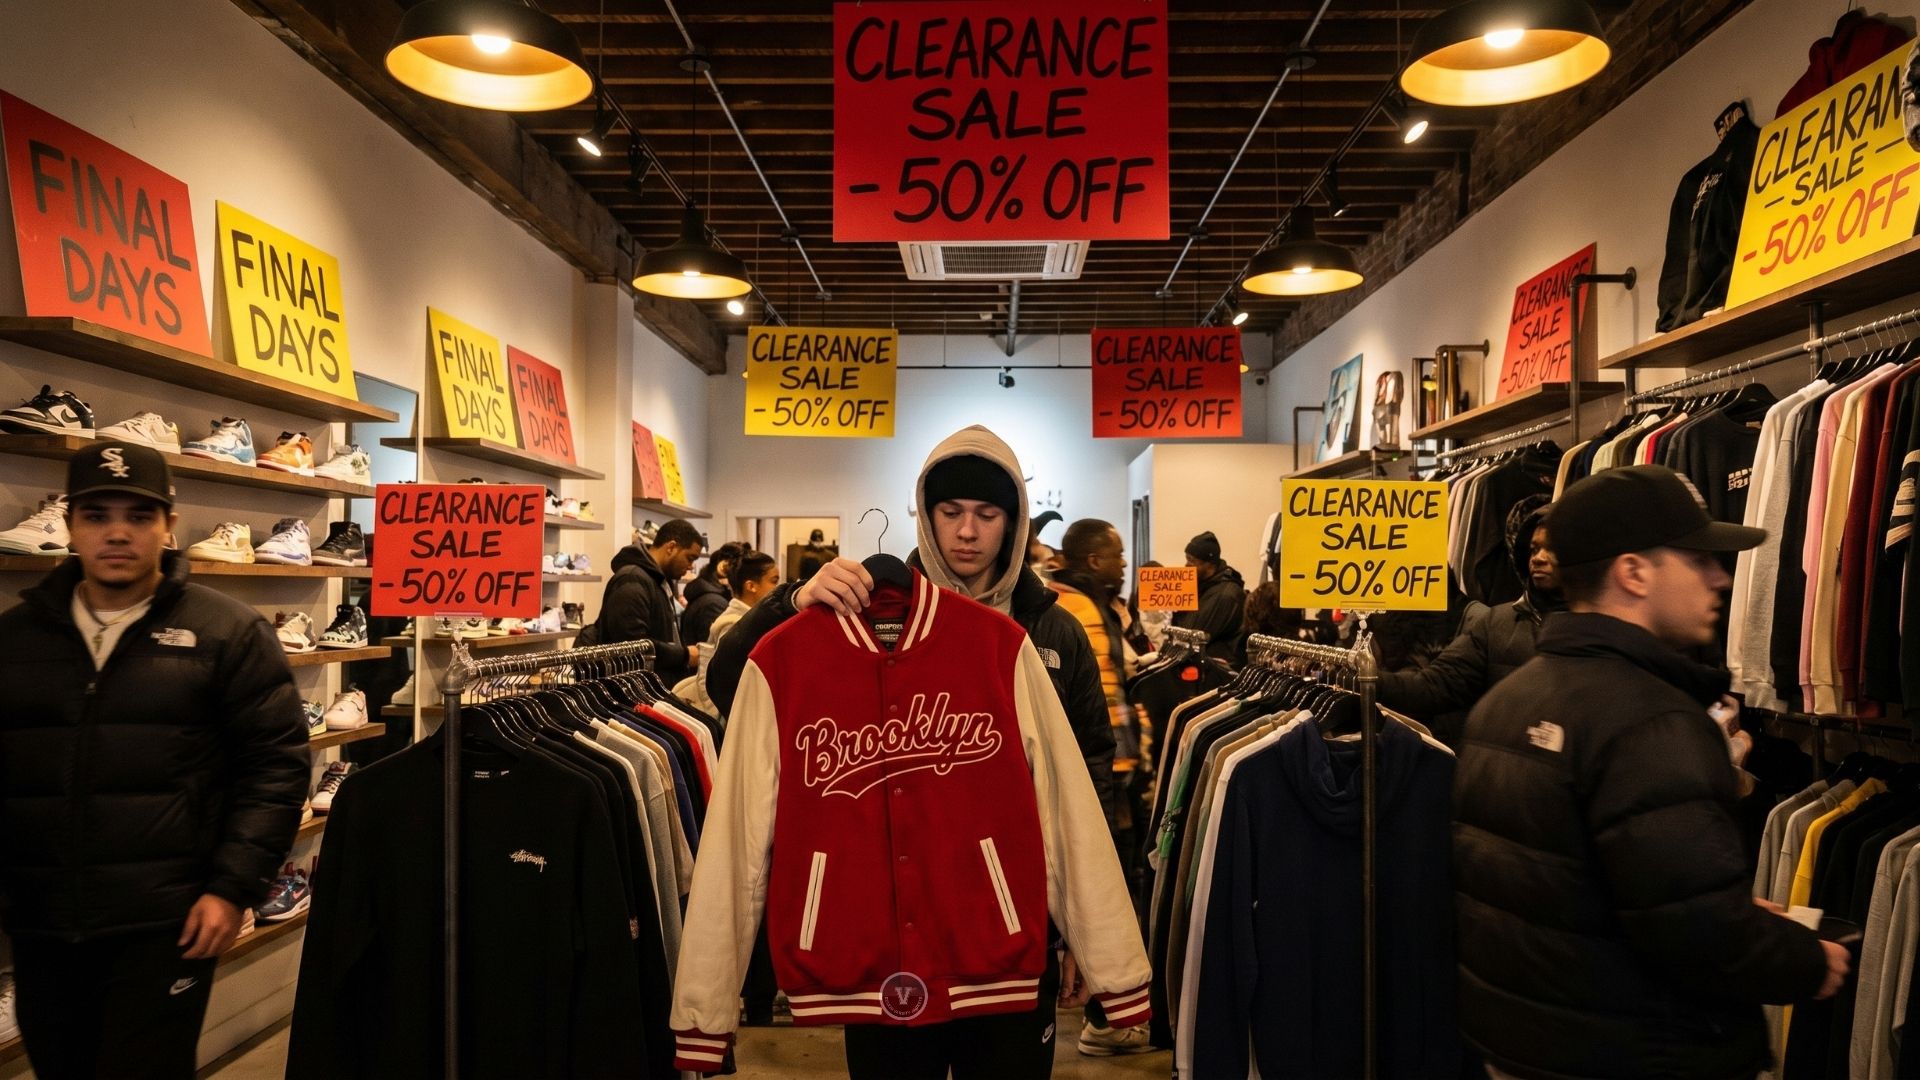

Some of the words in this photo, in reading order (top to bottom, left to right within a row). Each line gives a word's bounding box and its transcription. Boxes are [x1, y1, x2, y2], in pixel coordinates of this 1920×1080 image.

[845, 15, 1158, 83] CLEARANCE
[907, 87, 1088, 142] SALE
[28, 138, 192, 271] FINAL
[1042, 156, 1154, 224] OFF
[1837, 162, 1920, 245] OFF
[60, 236, 182, 336] DAYS
[231, 229, 340, 322] FINAL
[248, 304, 340, 384] DAYS
[1519, 306, 1563, 350] SALE
[439, 330, 504, 394] FINAL
[751, 333, 892, 364] CLEARANCE
[1095, 334, 1235, 366] CLEARANCE
[1539, 340, 1571, 381] OFF
[516, 364, 567, 418] FINAL
[779, 365, 860, 391] SALE
[1125, 366, 1203, 392] SALE
[453, 384, 506, 439] DAYS
[837, 399, 889, 429] OFF
[1184, 398, 1234, 428] OFF
[528, 411, 568, 457] DAYS
[380, 491, 539, 526] CLEARANCE
[1289, 486, 1442, 520] CLEARANCE
[410, 529, 502, 559] SALE
[1320, 522, 1409, 551] SALE
[474, 570, 535, 607] OFF
[1140, 570, 1194, 582] CLEARANCE
[1153, 582, 1182, 591] SALE
[1392, 565, 1444, 598] OFF
[1174, 594, 1194, 607] OFF
[796, 692, 1002, 787] Brooklyn
